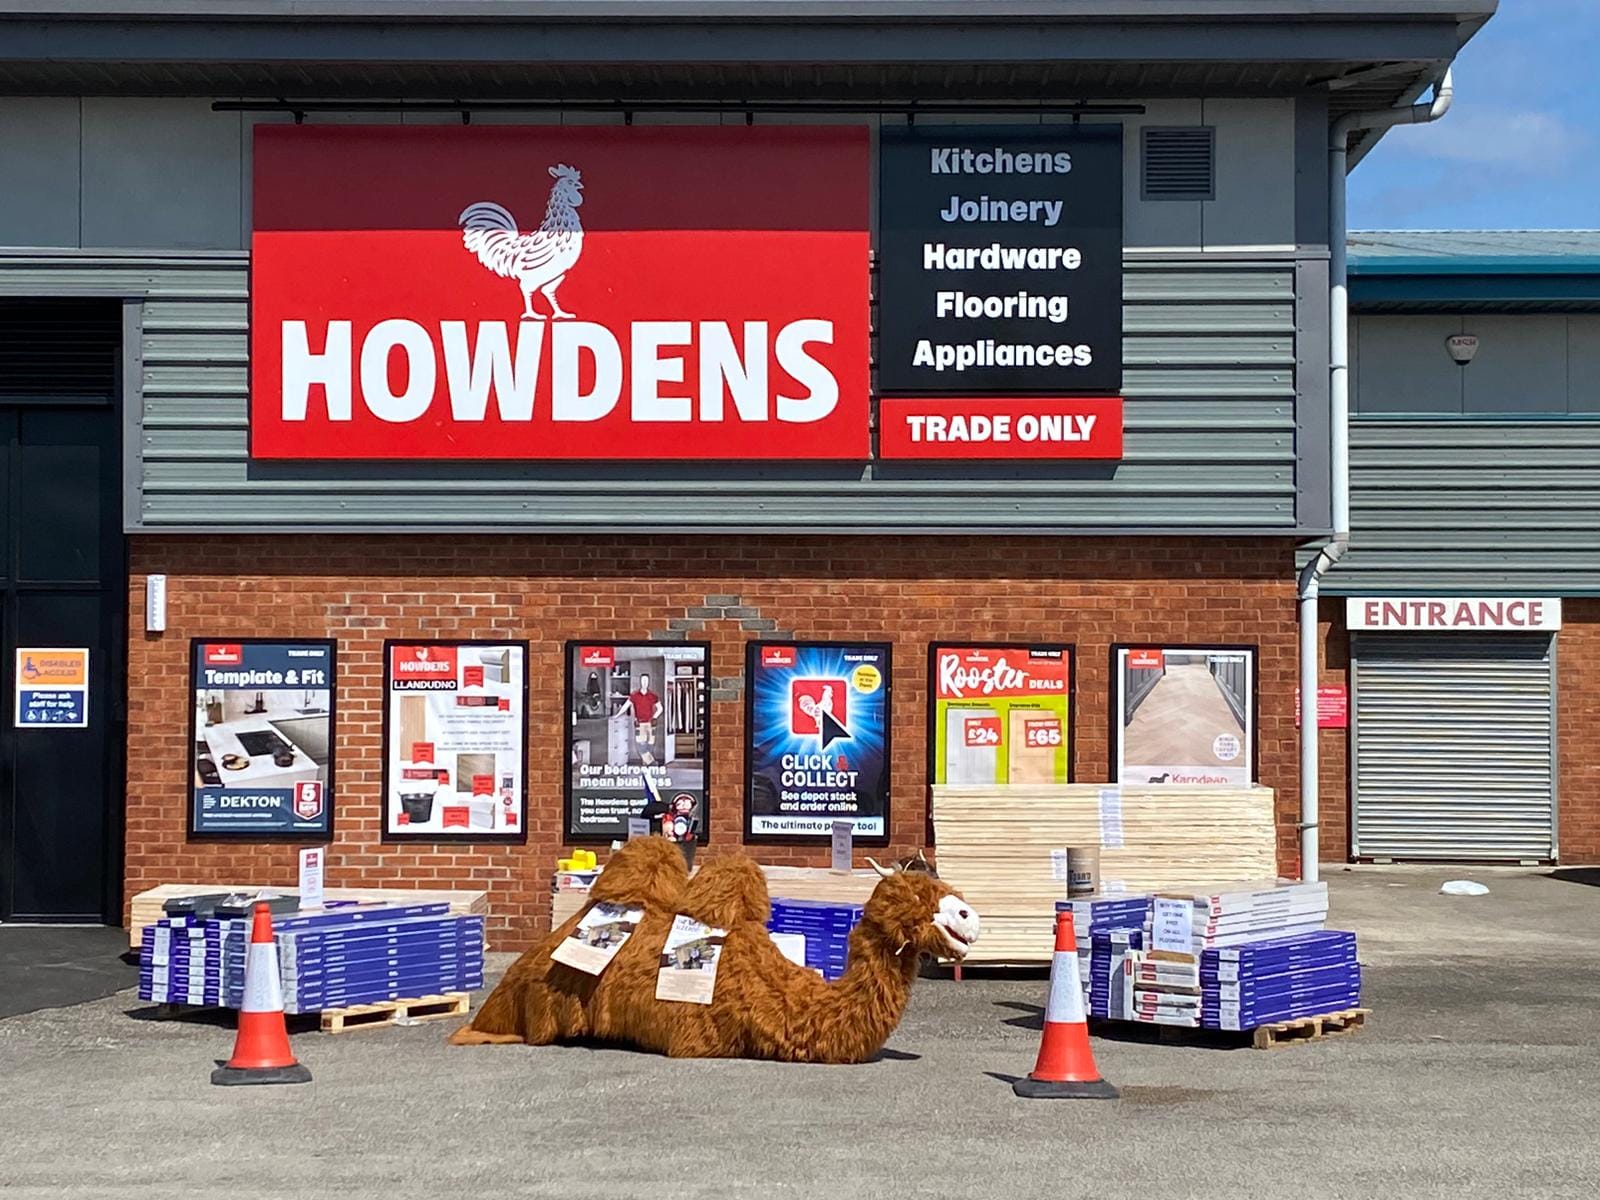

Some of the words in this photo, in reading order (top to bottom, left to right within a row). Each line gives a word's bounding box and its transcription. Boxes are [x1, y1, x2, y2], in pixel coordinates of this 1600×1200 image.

[931, 148, 1072, 175] Kitchens
[940, 196, 1064, 226] Joinery
[923, 243, 1082, 270] Hardware
[936, 291, 1069, 323] Flooring
[912, 339, 1093, 372] Appliances
[281, 318, 839, 424] HOWDENS
[906, 415, 1011, 442] TRADE
[1016, 415, 1097, 442] ONLY
[1364, 601, 1543, 626] ENTRANCE
[40, 659, 82, 668] DISABLED
[400, 661, 451, 673] HOWDENS
[205, 669, 284, 688] Template
[285, 669, 300, 685] &
[301, 669, 325, 685] Fit
[940, 654, 1031, 698] Rooster
[393, 681, 457, 690] LLANDUDNO
[1029, 679, 1064, 690] DEALS
[58, 701, 76, 709] help
[968, 728, 999, 745] £24
[1028, 729, 1062, 745] £65
[580, 764, 603, 775] Our
[782, 755, 833, 771] CLICK
[580, 778, 615, 787] mean
[781, 771, 859, 788] COLLECT
[302, 783, 317, 802] 5
[781, 791, 800, 801] See
[801, 790, 829, 803] depot
[830, 790, 858, 801] stock
[220, 796, 281, 808] DEKTON
[580, 798, 595, 806] The
[779, 802, 799, 811] and
[800, 802, 827, 811] order
[827, 802, 858, 812] online
[580, 808, 595, 816] you
[761, 820, 779, 830] The
[780, 821, 823, 830] ultimate
[858, 822, 878, 831] tool
